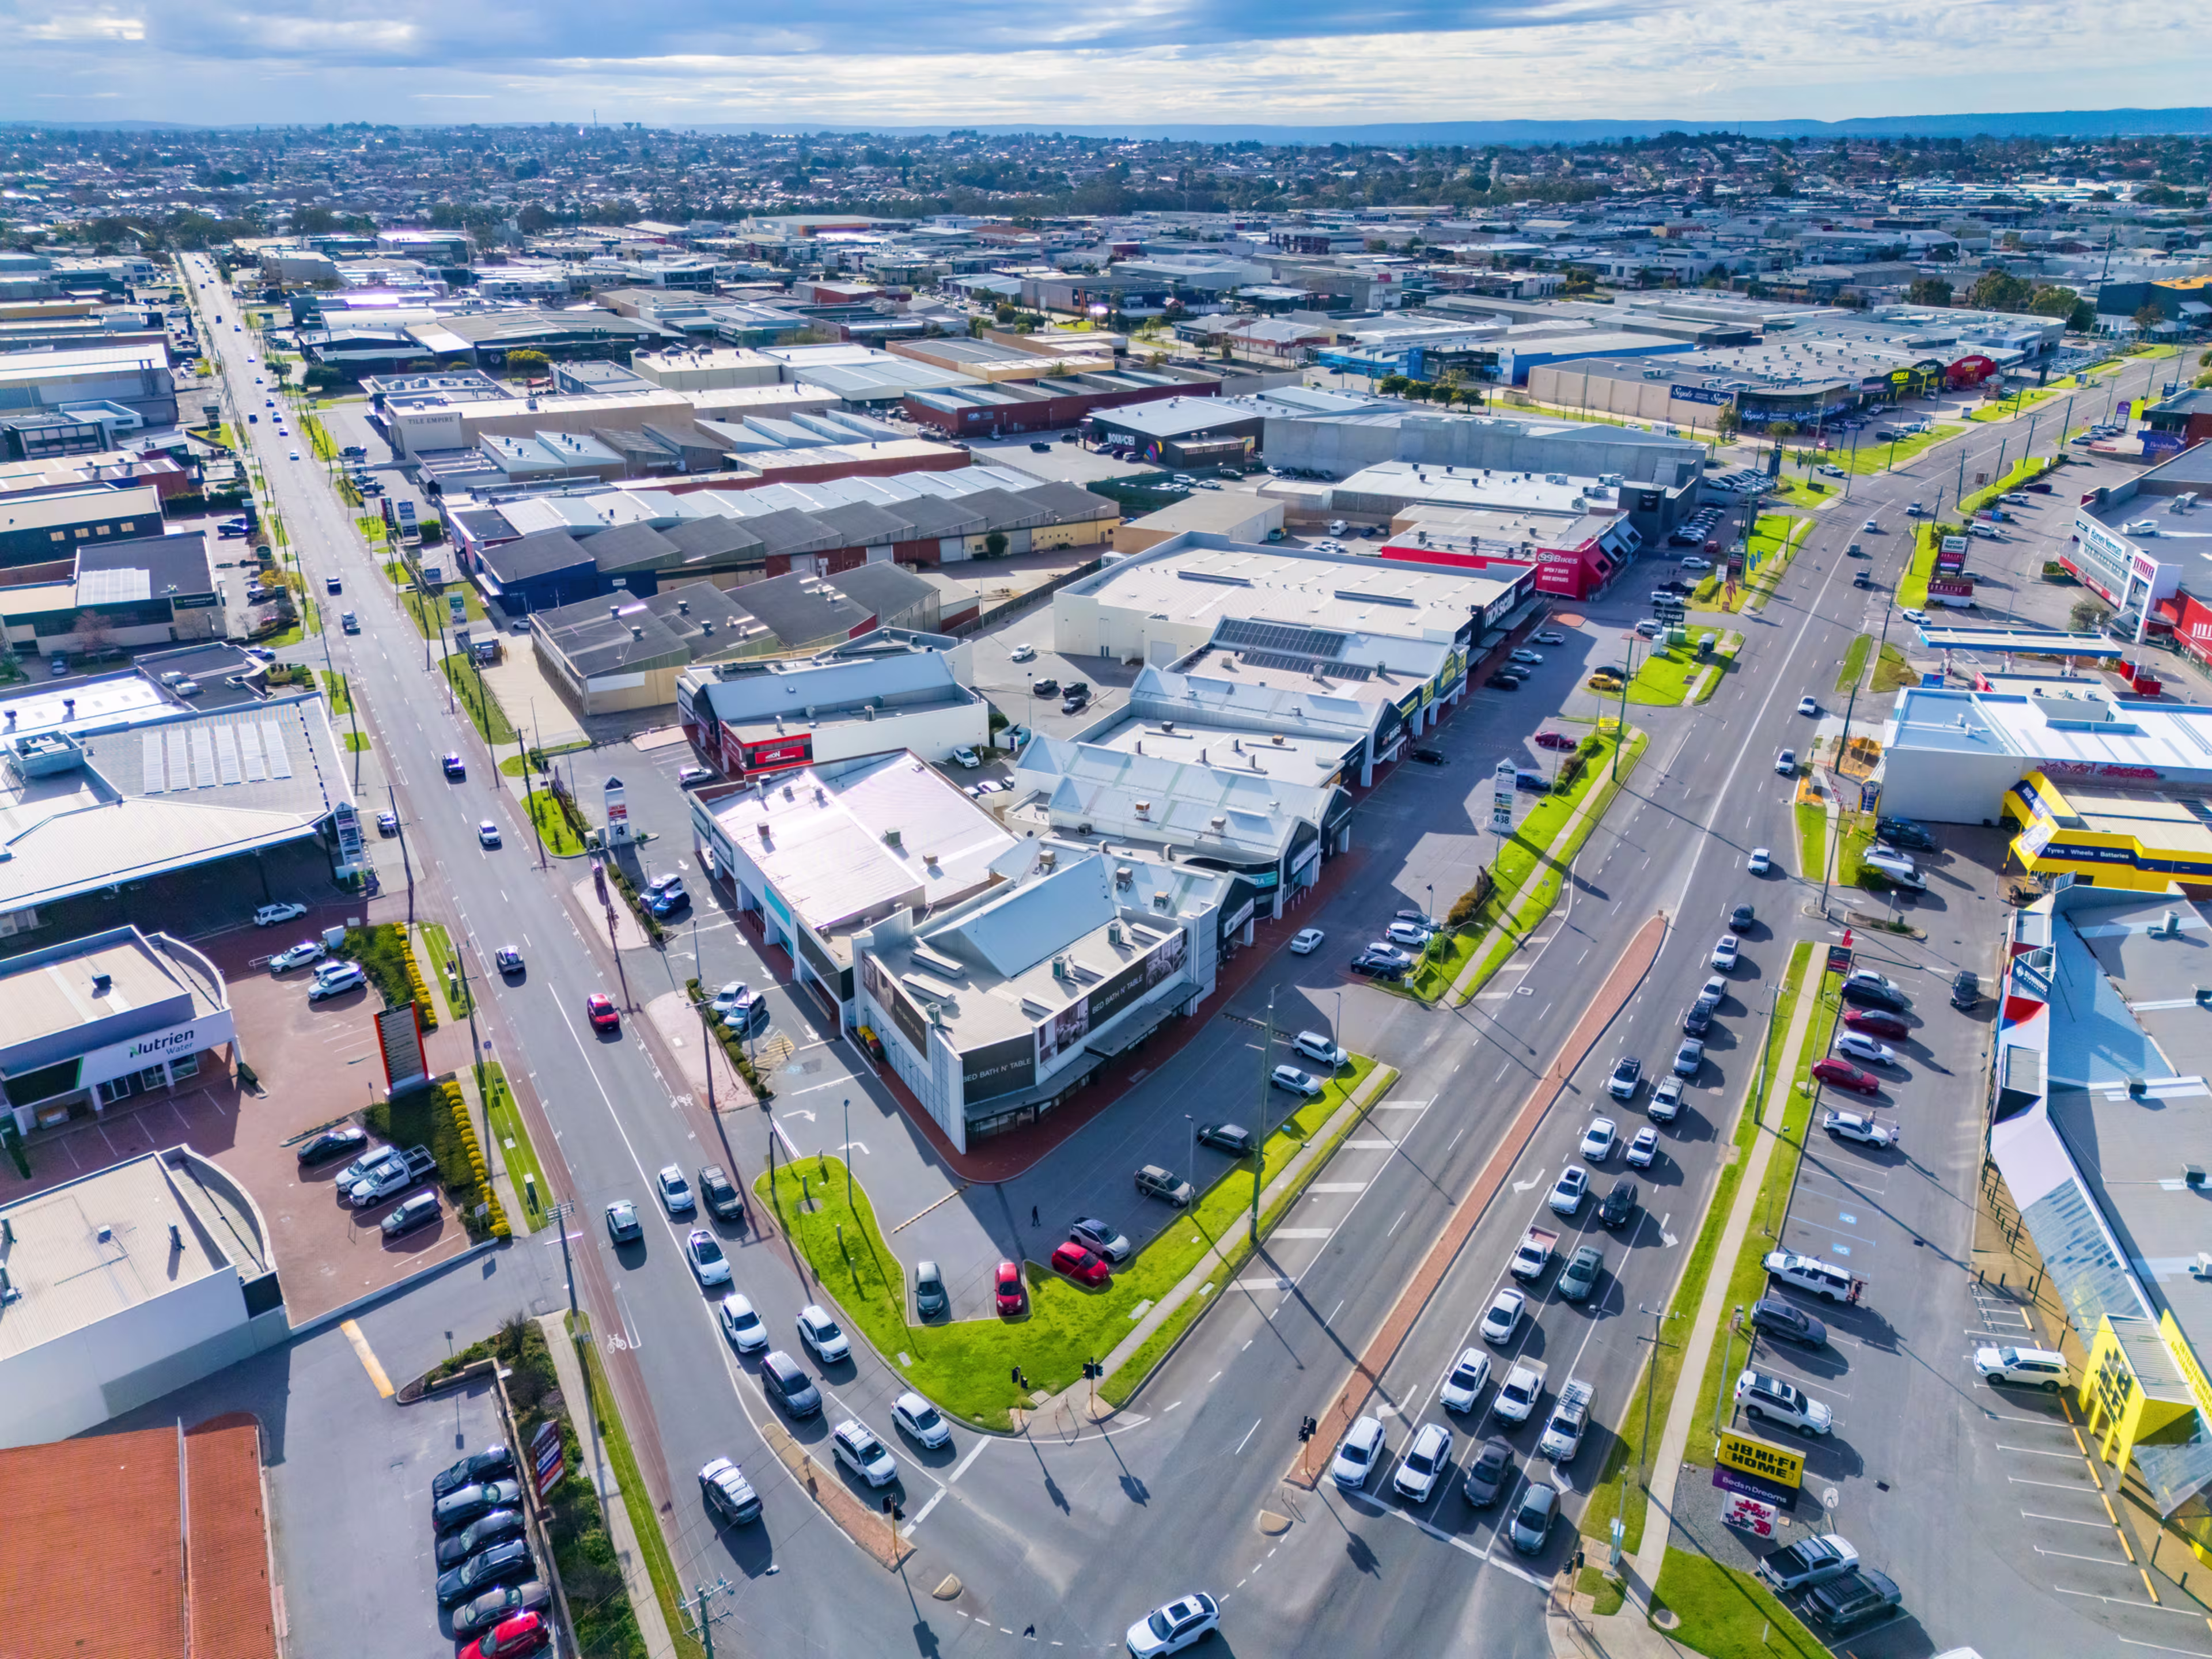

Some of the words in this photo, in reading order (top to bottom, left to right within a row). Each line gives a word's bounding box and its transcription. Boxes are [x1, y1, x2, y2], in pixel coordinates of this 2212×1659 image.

[1892, 372, 1910, 381] RSEA
[427, 416, 454, 424] EMPIRE
[2091, 528, 2105, 545] Harvey
[2105, 536, 2122, 557] Norman
[615, 826, 625, 836] 4
[2100, 851, 2130, 859] Batteries
[2024, 970, 2048, 993] RUNNING
[1092, 1001, 1104, 1014] BED
[1105, 990, 1119, 1005] BATH
[1127, 974, 1143, 990] TABLE
[130, 1030, 194, 1058] Nutrien
[166, 1042, 194, 1055] Water
[963, 1073, 978, 1083] BED
[980, 1067, 999, 1078] BATH
[1010, 1057, 1032, 1069] TABLE
[1727, 1442, 1753, 1457] JB
[1732, 1453, 1787, 1479] HOME
[1722, 1476, 1744, 1489] Beds
[1752, 1486, 1787, 1503] Dreams
